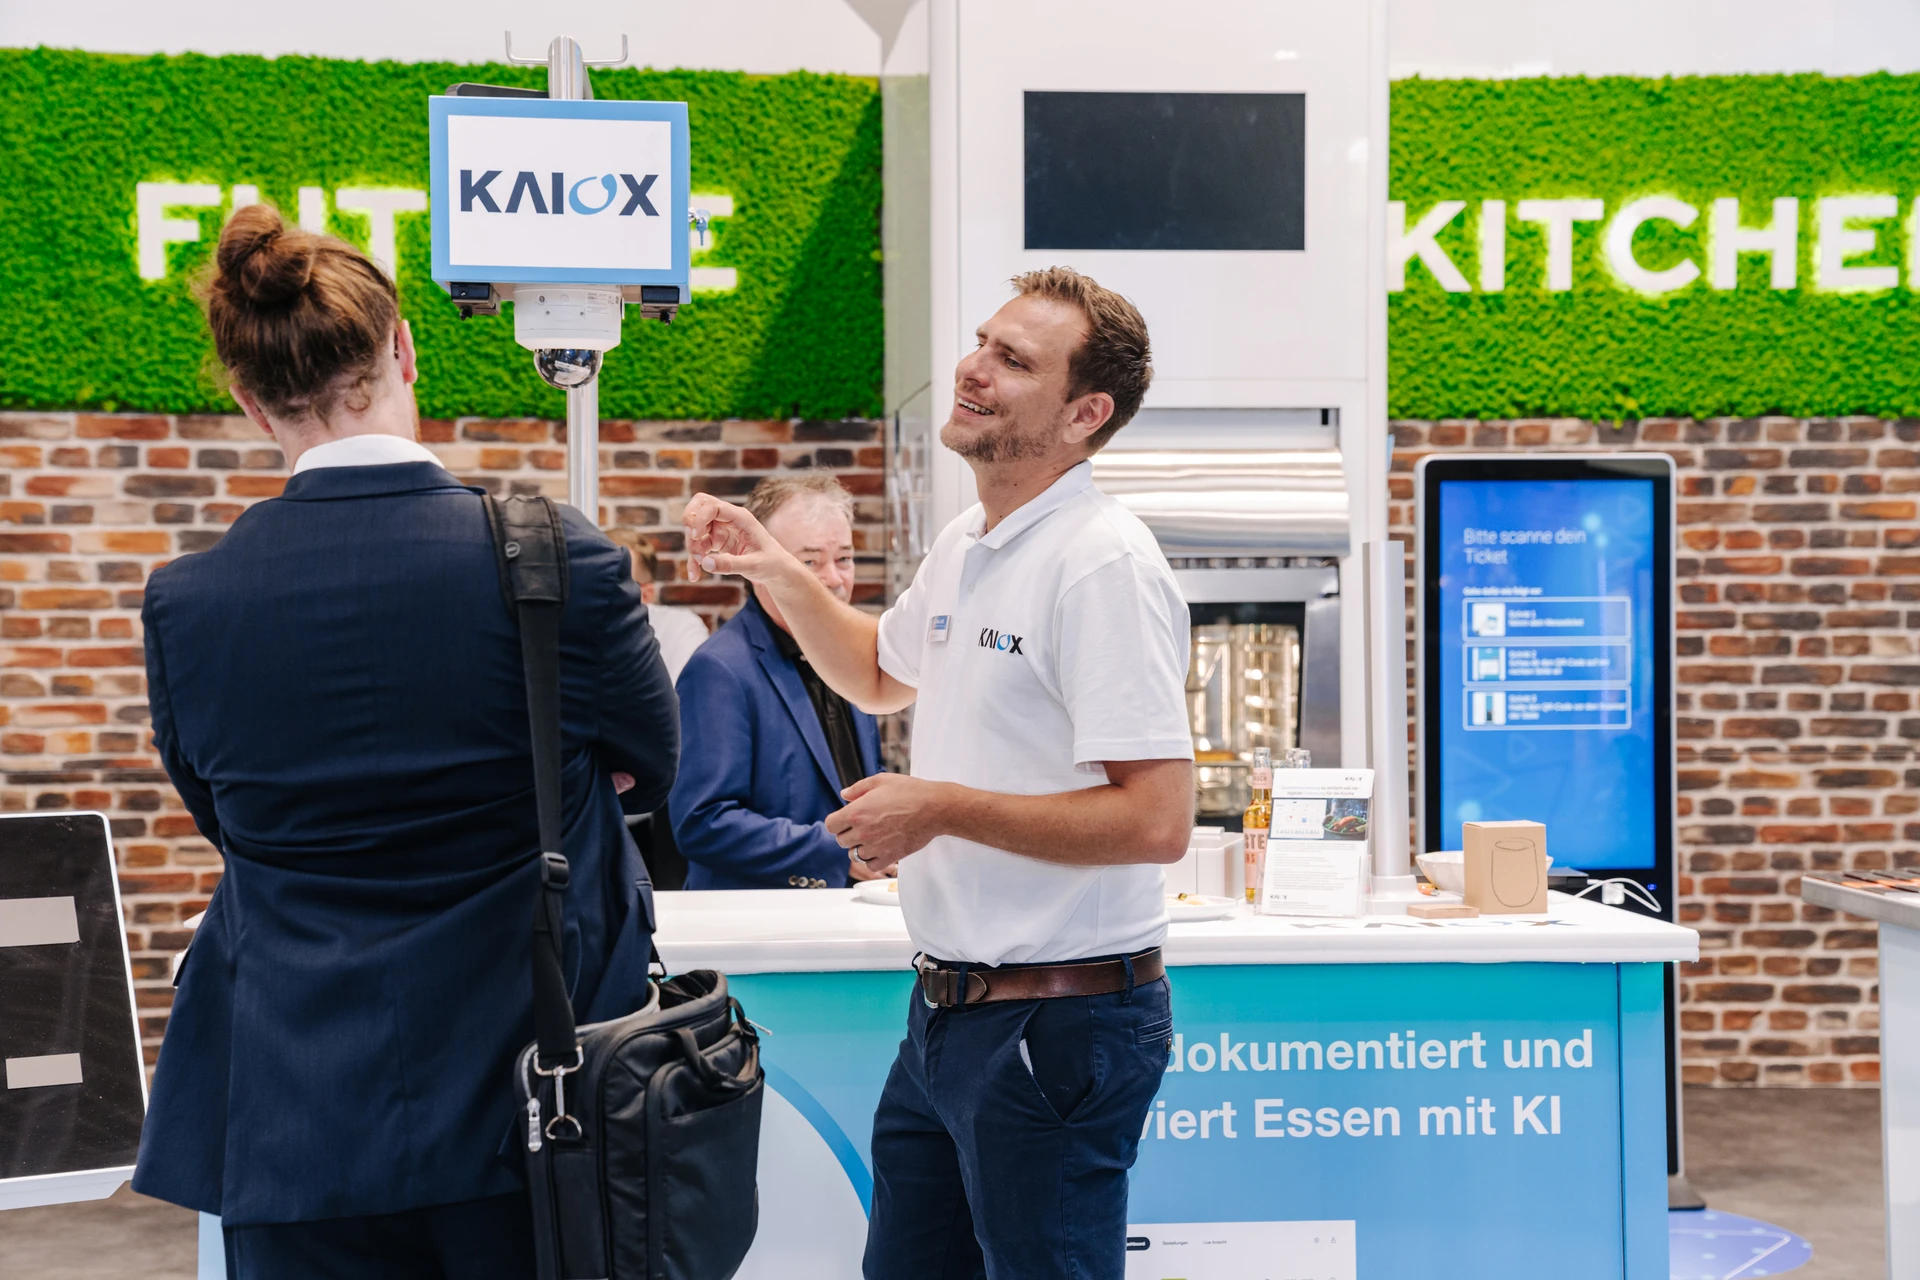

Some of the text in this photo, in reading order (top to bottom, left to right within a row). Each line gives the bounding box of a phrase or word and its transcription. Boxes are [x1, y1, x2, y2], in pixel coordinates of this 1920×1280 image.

[460, 169, 660, 217] KAIOX
[1387, 196, 1920, 293] KITCHE
[1463, 527, 1587, 545] Bitte scanne dein
[1465, 548, 1508, 565] Ticket
[1503, 1029, 1593, 1069] und
[1254, 1098, 1401, 1139] Essen
[1418, 1096, 1497, 1136] mit
[1513, 1095, 1562, 1135] KI
